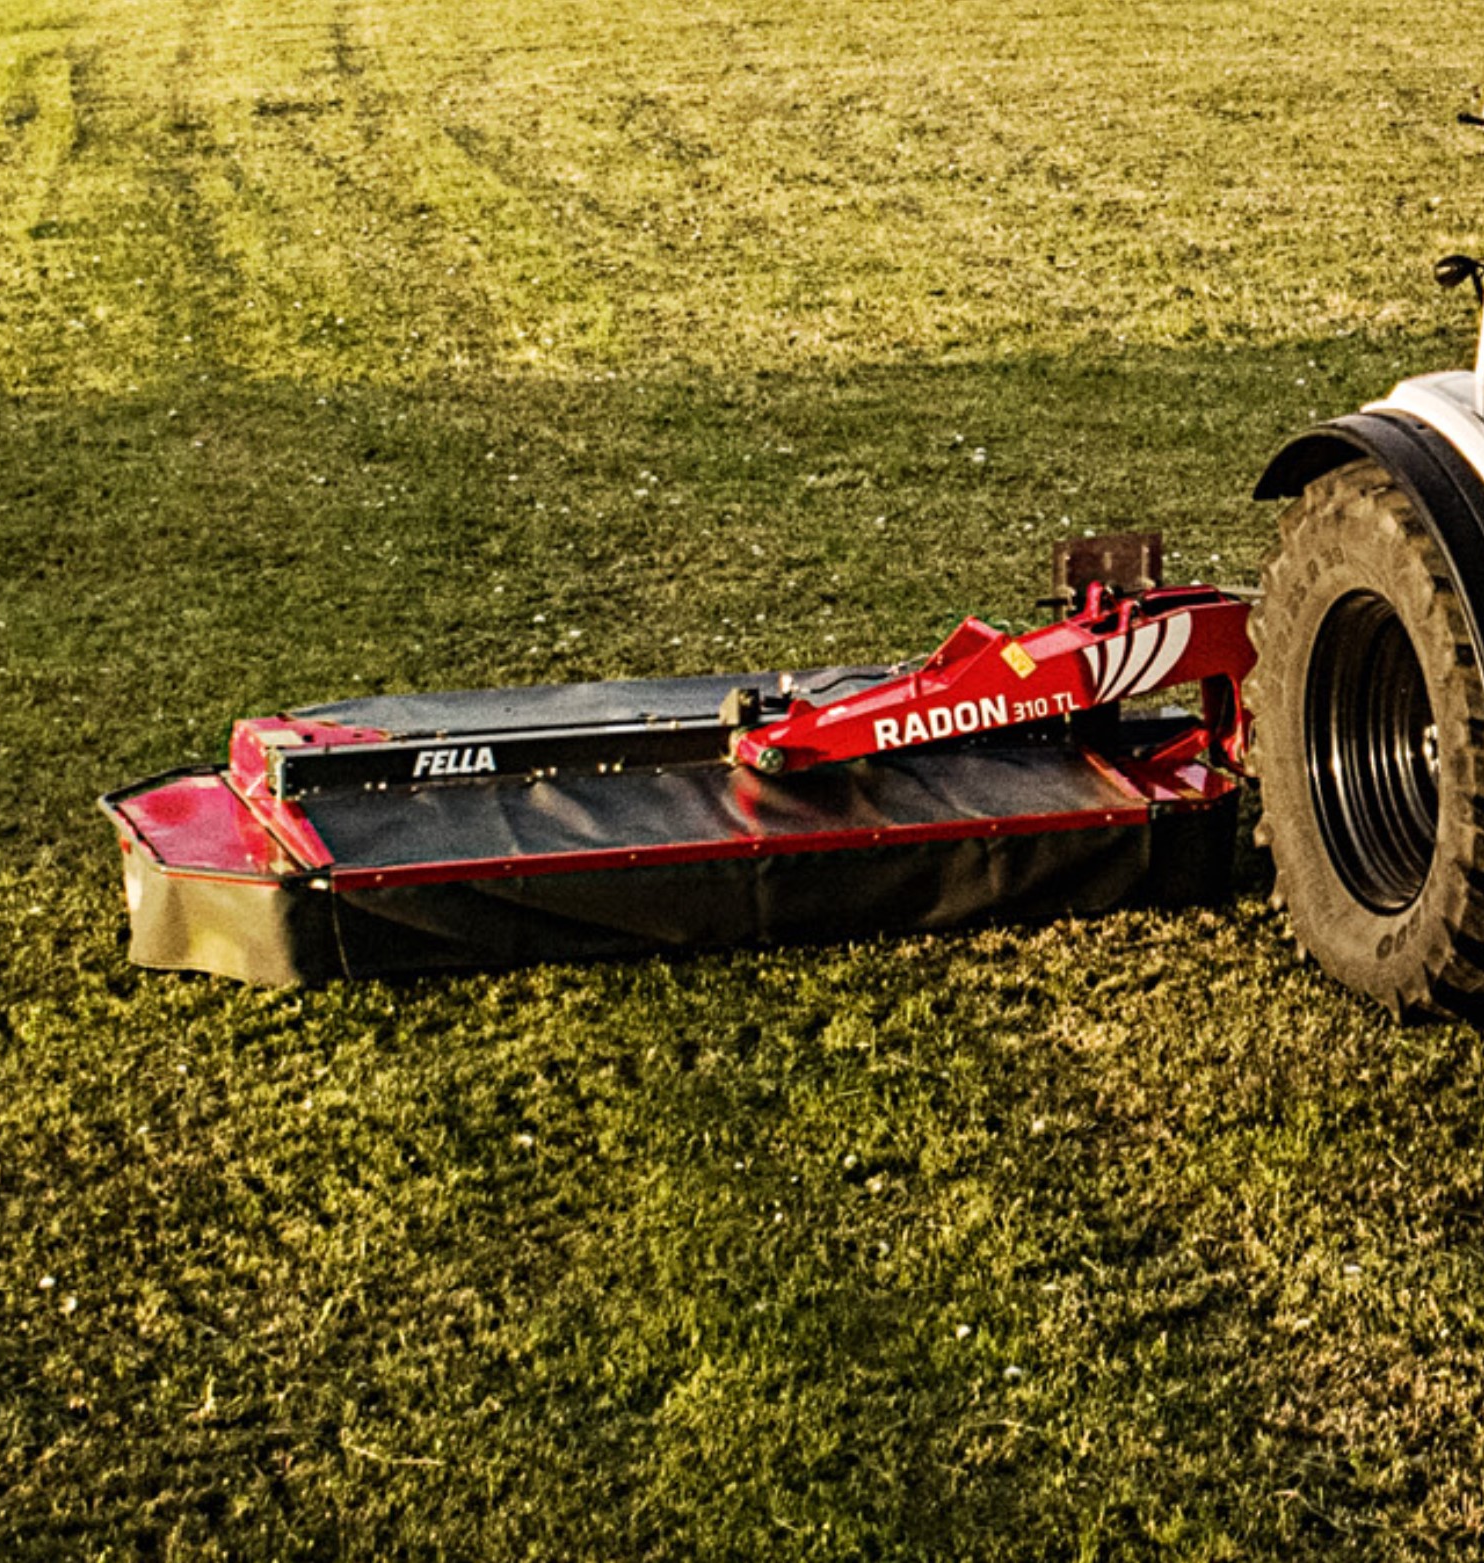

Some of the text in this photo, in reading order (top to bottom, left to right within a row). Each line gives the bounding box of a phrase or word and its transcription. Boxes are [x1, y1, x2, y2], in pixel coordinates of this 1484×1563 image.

[873, 691, 1081, 750] RADON 310 TL
[413, 746, 496, 778] FELLA
